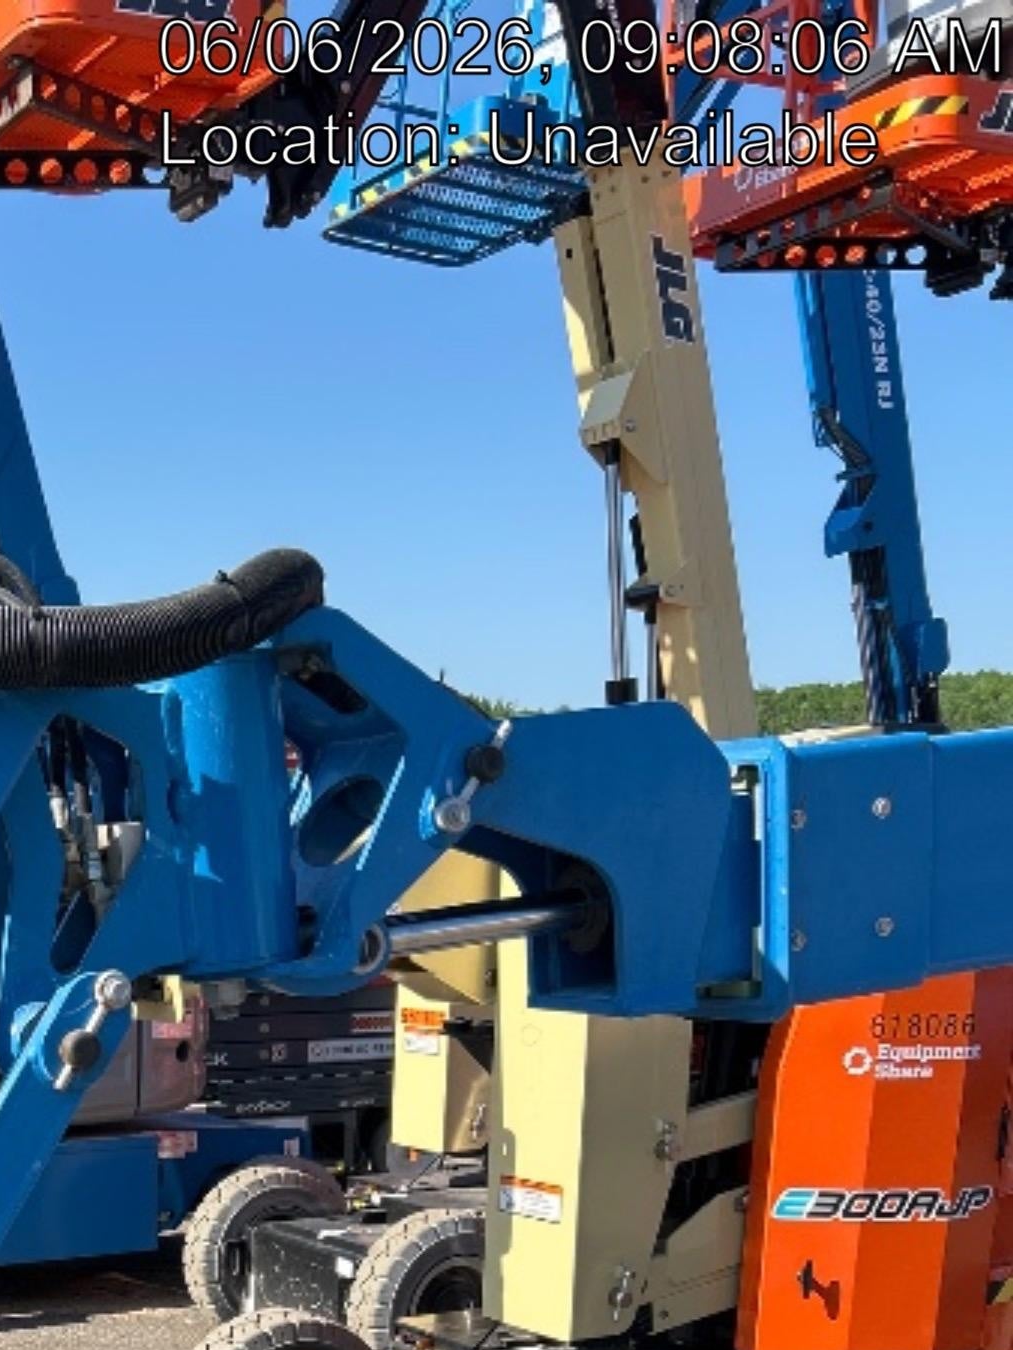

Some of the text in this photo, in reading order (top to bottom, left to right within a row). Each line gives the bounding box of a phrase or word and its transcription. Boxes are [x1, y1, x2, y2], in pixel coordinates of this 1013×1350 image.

[652, 236, 694, 342] JLG
[876, 380, 894, 409] RJ
[877, 1043, 981, 1062] Equipment
[874, 1063, 933, 1078] Share
[772, 1187, 992, 1222] E300AJP
